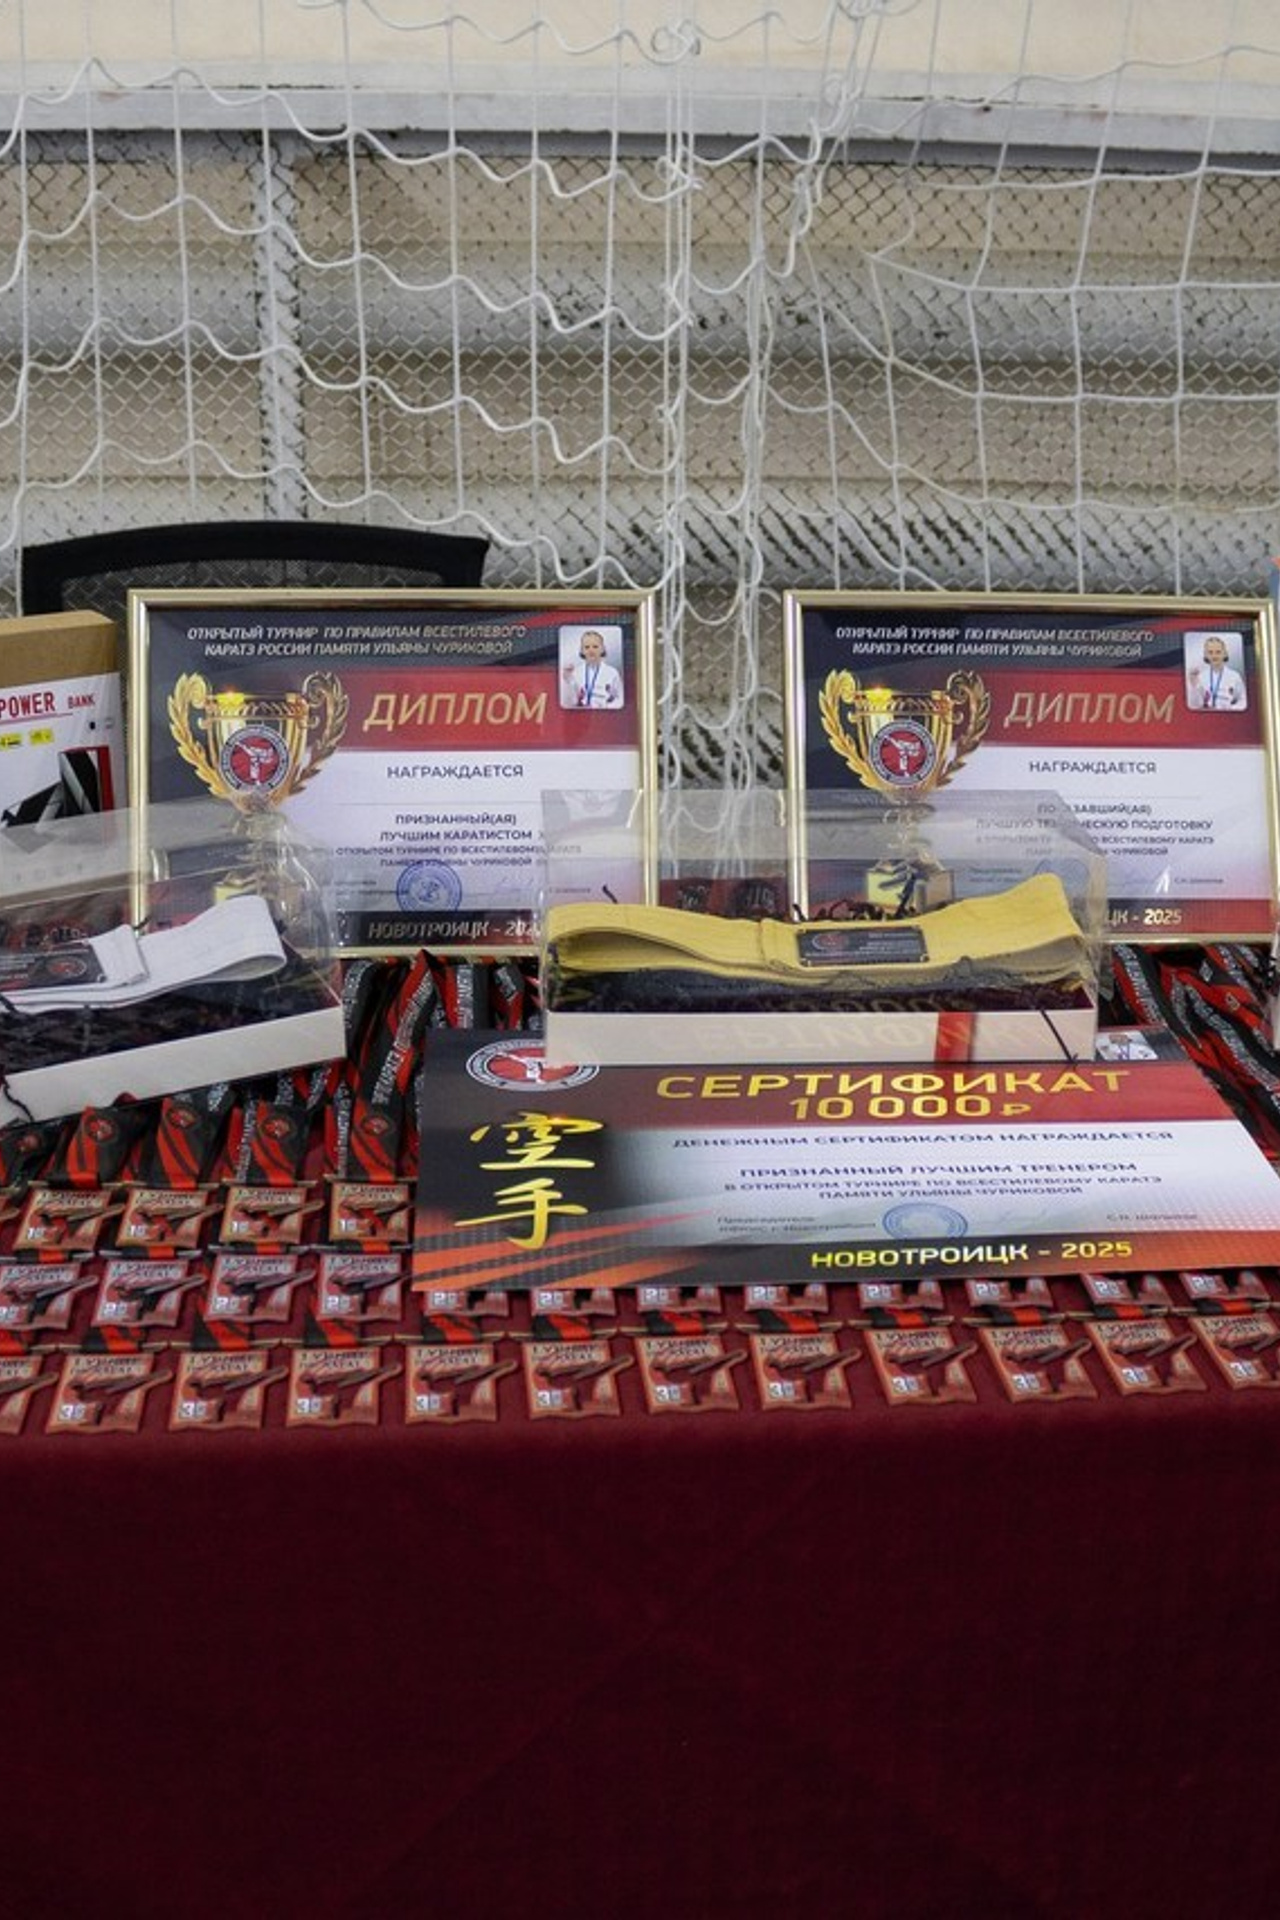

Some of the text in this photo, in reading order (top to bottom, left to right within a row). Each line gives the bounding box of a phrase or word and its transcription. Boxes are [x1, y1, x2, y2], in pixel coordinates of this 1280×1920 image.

[187, 625, 263, 640] ОТКРЫТЫЙ
[266, 627, 318, 639] ТУРНИР
[323, 627, 343, 639] ПО
[964, 628, 984, 639] ПО
[257, 643, 312, 656] РОССИИ
[0, 692, 96, 719] POWER BANK
[362, 691, 546, 732] ДИПЛОМ
[1002, 691, 1175, 729] ДИПЛОМ
[387, 763, 524, 780] НАГРАЖДАЕТСЯ
[1029, 760, 1157, 775] НАГРАЖДАЕТСЯ
[395, 812, 517, 826] ПРИЗНАННЫЙ(АЯ)
[1131, 819, 1213, 831] ПОДГОТОВКУ
[380, 829, 533, 842] ЛУЧШИМ КАРАТИСТОМ
[1143, 908, 1182, 925] 2025
[368, 920, 490, 939] НОВОТРОИЦК
[656, 1070, 1131, 1099] СЕРТИФИКАТ
[789, 1096, 854, 1120] 10
[672, 1131, 1174, 1148] ДЕНЕЖНЫМ СЕРТИФИКАТОМ НАГРАЖДАЕТСЯ
[739, 1162, 1138, 1178] ПРИЗНАННЫЙ ЛУЧШИМ ТРЕНЕРОМ
[811, 1242, 1029, 1268] НОВОТРОИЦК
[1060, 1241, 1133, 1260] 2025
